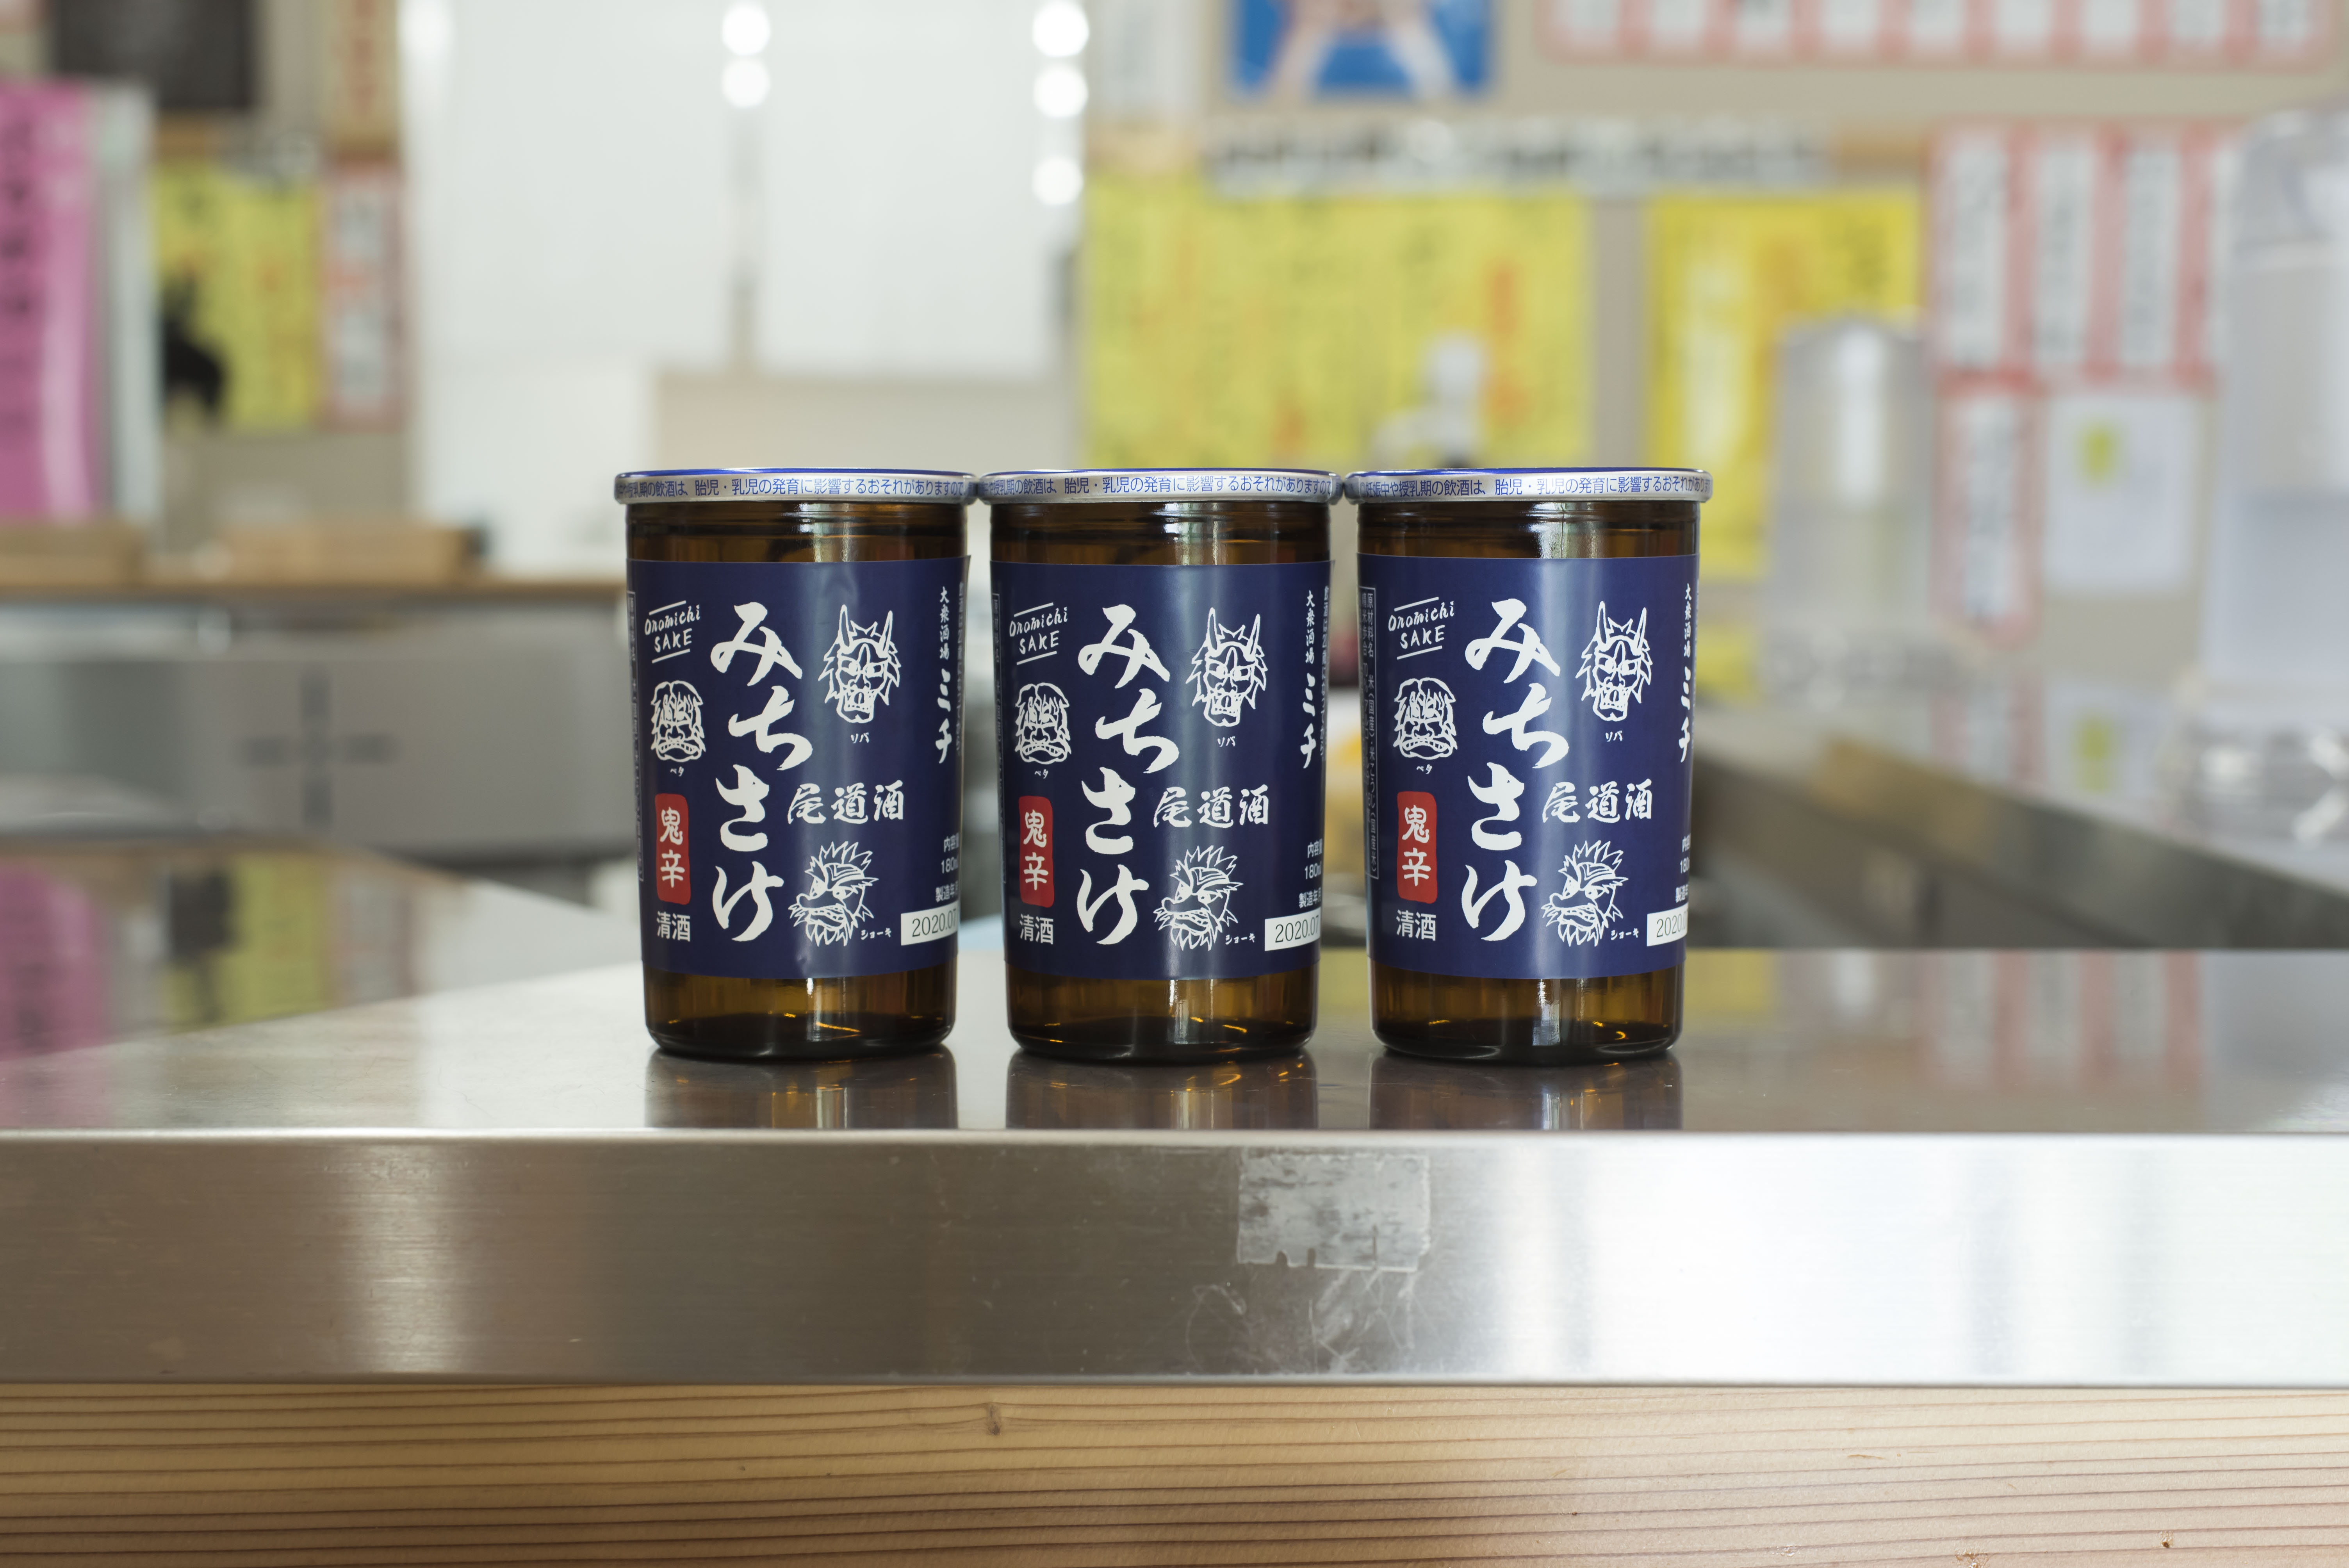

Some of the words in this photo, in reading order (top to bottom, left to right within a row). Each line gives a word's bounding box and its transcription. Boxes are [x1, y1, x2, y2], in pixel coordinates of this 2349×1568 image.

[645, 604, 700, 635] Onomichi
[939, 586, 949, 660] 大衆酒場
[1009, 606, 1068, 637] Onomichi
[1305, 590, 1315, 665] 大衆酒場
[1388, 600, 1454, 631] Onomichi
[1400, 625, 1445, 649] SAKE
[654, 628, 692, 653] SAKE
[1019, 630, 1059, 655] SAKE
[710, 602, 813, 942] みちさけ
[1076, 604, 1180, 945] みちさけ
[1461, 598, 1570, 942] みちさけ
[787, 780, 904, 824] 尾道酒
[1153, 784, 1269, 828] 尾道酒
[1542, 779, 1652, 823] 尾道酒
[659, 807, 685, 888] 鬼辛
[1023, 809, 1049, 891] 鬼辛
[1402, 804, 1431, 887] 鬼辛
[656, 911, 690, 942] 清酒
[1019, 913, 1053, 945] 清酒
[1275, 914, 1319, 943] 2020.07
[1396, 910, 1436, 941] 清酒
